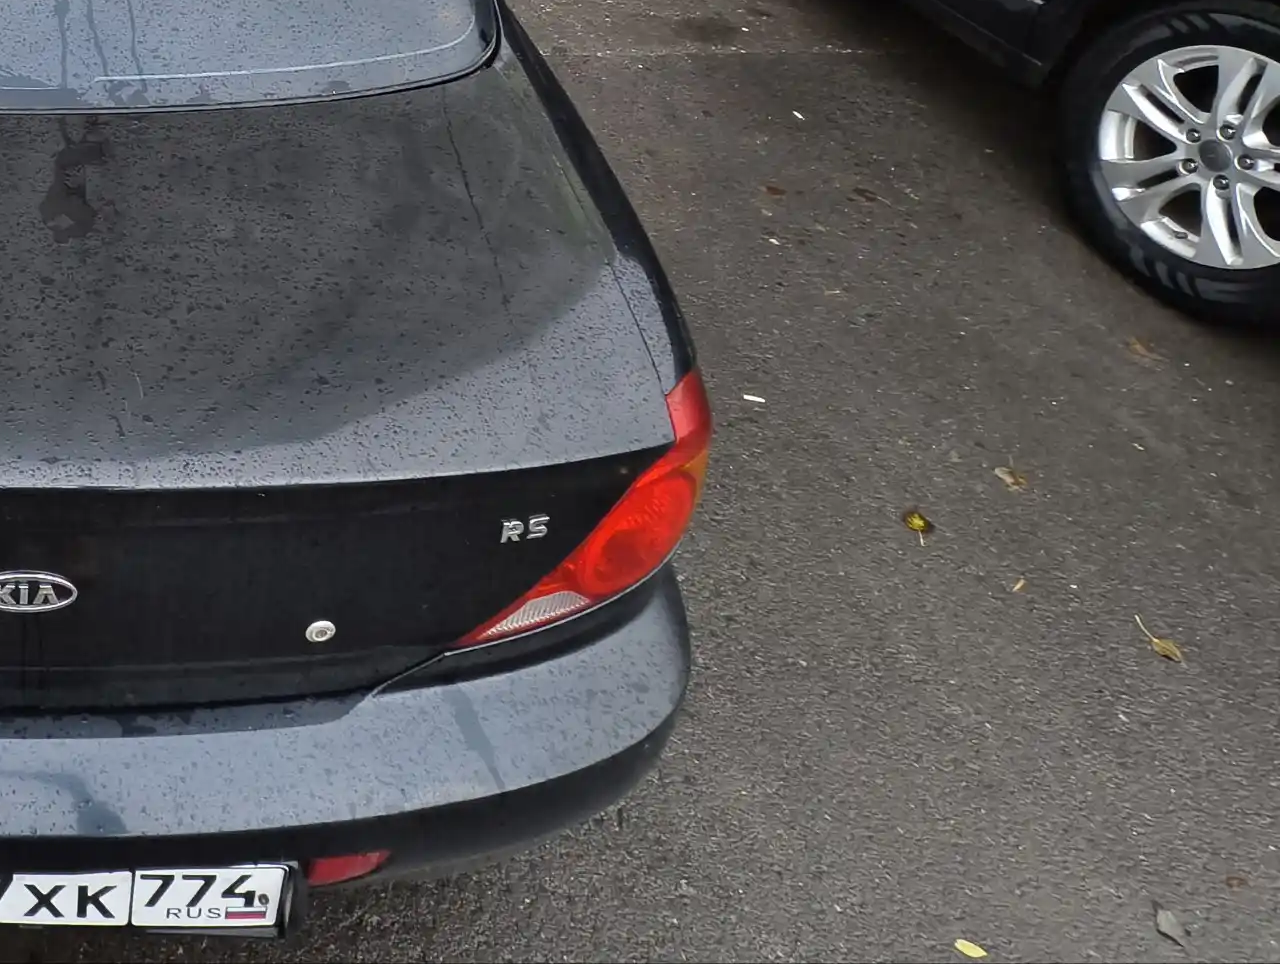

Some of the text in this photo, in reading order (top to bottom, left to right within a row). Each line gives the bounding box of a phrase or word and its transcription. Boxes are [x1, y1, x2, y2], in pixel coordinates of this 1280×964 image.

[500, 514, 550, 543] RS
[140, 874, 256, 908] 774
[166, 907, 221, 919] RUS
